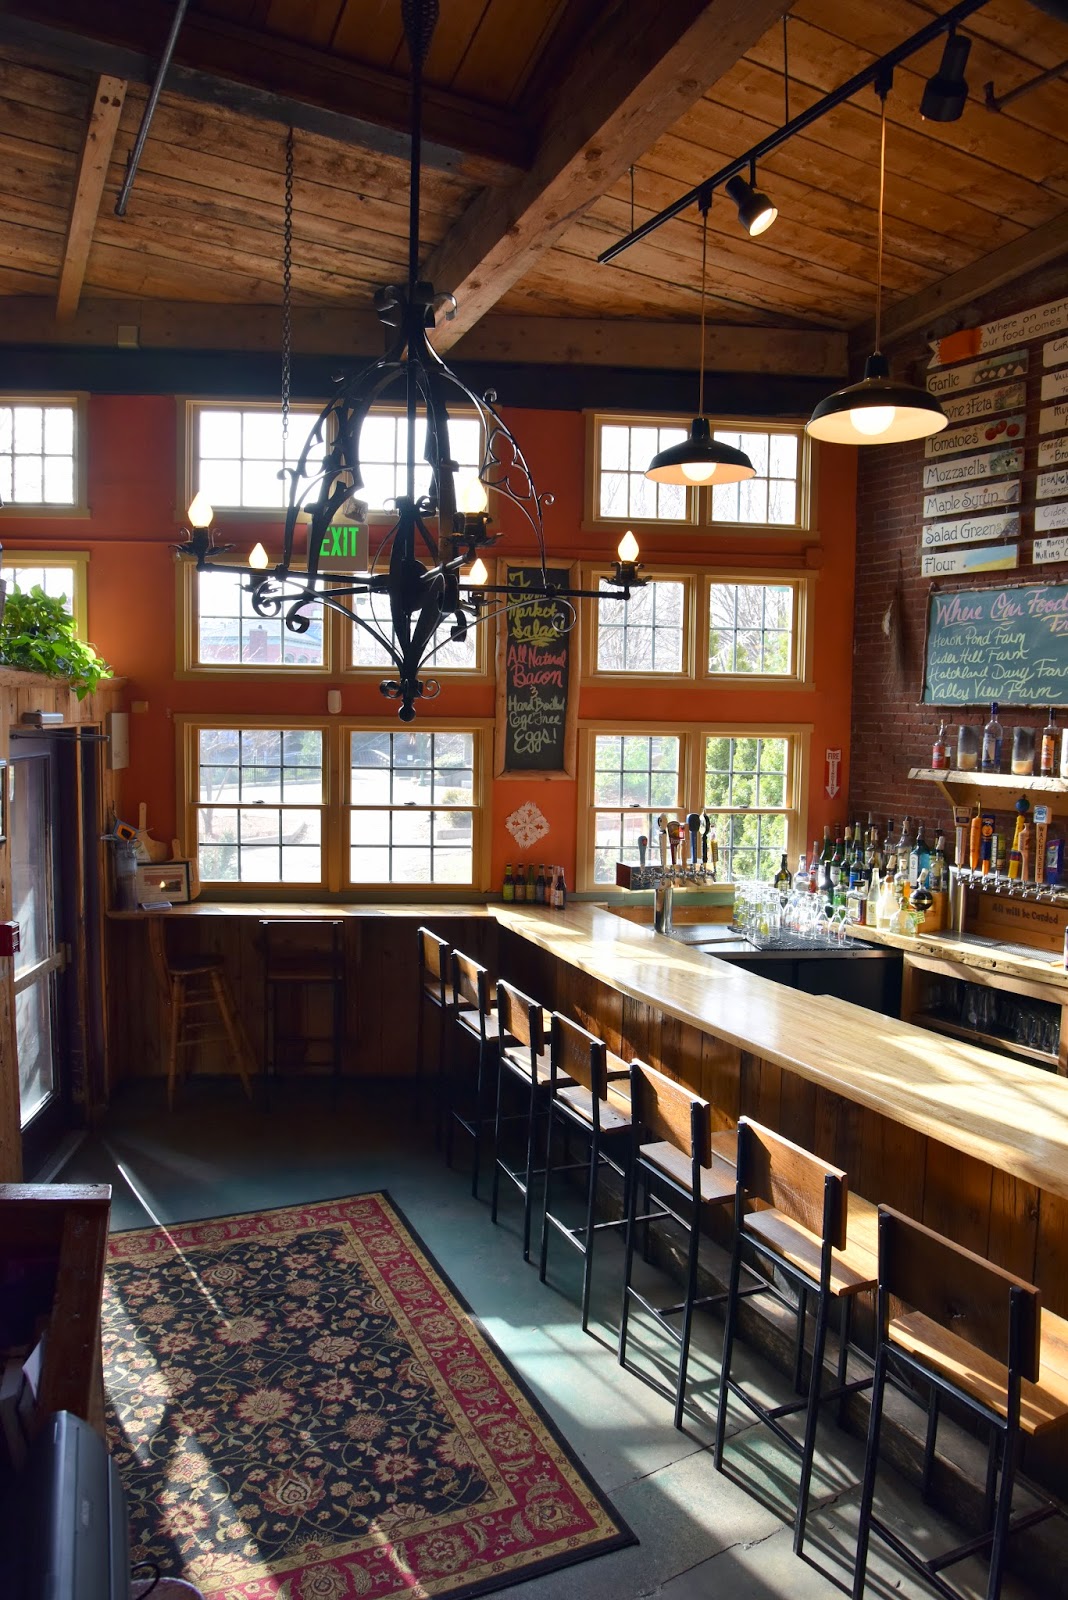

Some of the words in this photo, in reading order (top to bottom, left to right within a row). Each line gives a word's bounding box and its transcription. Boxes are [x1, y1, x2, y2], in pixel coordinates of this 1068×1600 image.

[987, 320, 1017, 335] Where
[1023, 313, 1037, 323] on
[1043, 303, 1068, 317] eart
[982, 338, 998, 348] our
[1002, 327, 1025, 343] food
[1028, 317, 1062, 333] comes
[928, 374, 960, 392] Garlic
[928, 432, 979, 453] Tomatoes
[926, 459, 985, 484] Mozzarella
[926, 495, 960, 513] Maple
[962, 491, 999, 509] Syrup
[319, 527, 359, 556] EXIT
[925, 526, 958, 544] Salad
[960, 522, 1002, 539] Greens
[925, 557, 956, 573] Flour
[935, 593, 983, 625] Where
[990, 592, 1025, 621] Our
[931, 633, 964, 647] Heron
[965, 625, 991, 646] Pond
[991, 626, 1026, 651] Farm
[929, 651, 961, 665] Cider
[960, 648, 985, 664] Hill
[986, 647, 1029, 663] Farm
[510, 664, 563, 688] Bacon
[1033, 658, 1068, 678] Far
[931, 683, 969, 700] Valley
[974, 679, 1004, 698] View
[1004, 680, 1062, 699] Farm
[827, 752, 840, 760] FIRE
[1006, 907, 1020, 917] will
[1022, 909, 1030, 919] be
[1031, 911, 1059, 924] Carded
